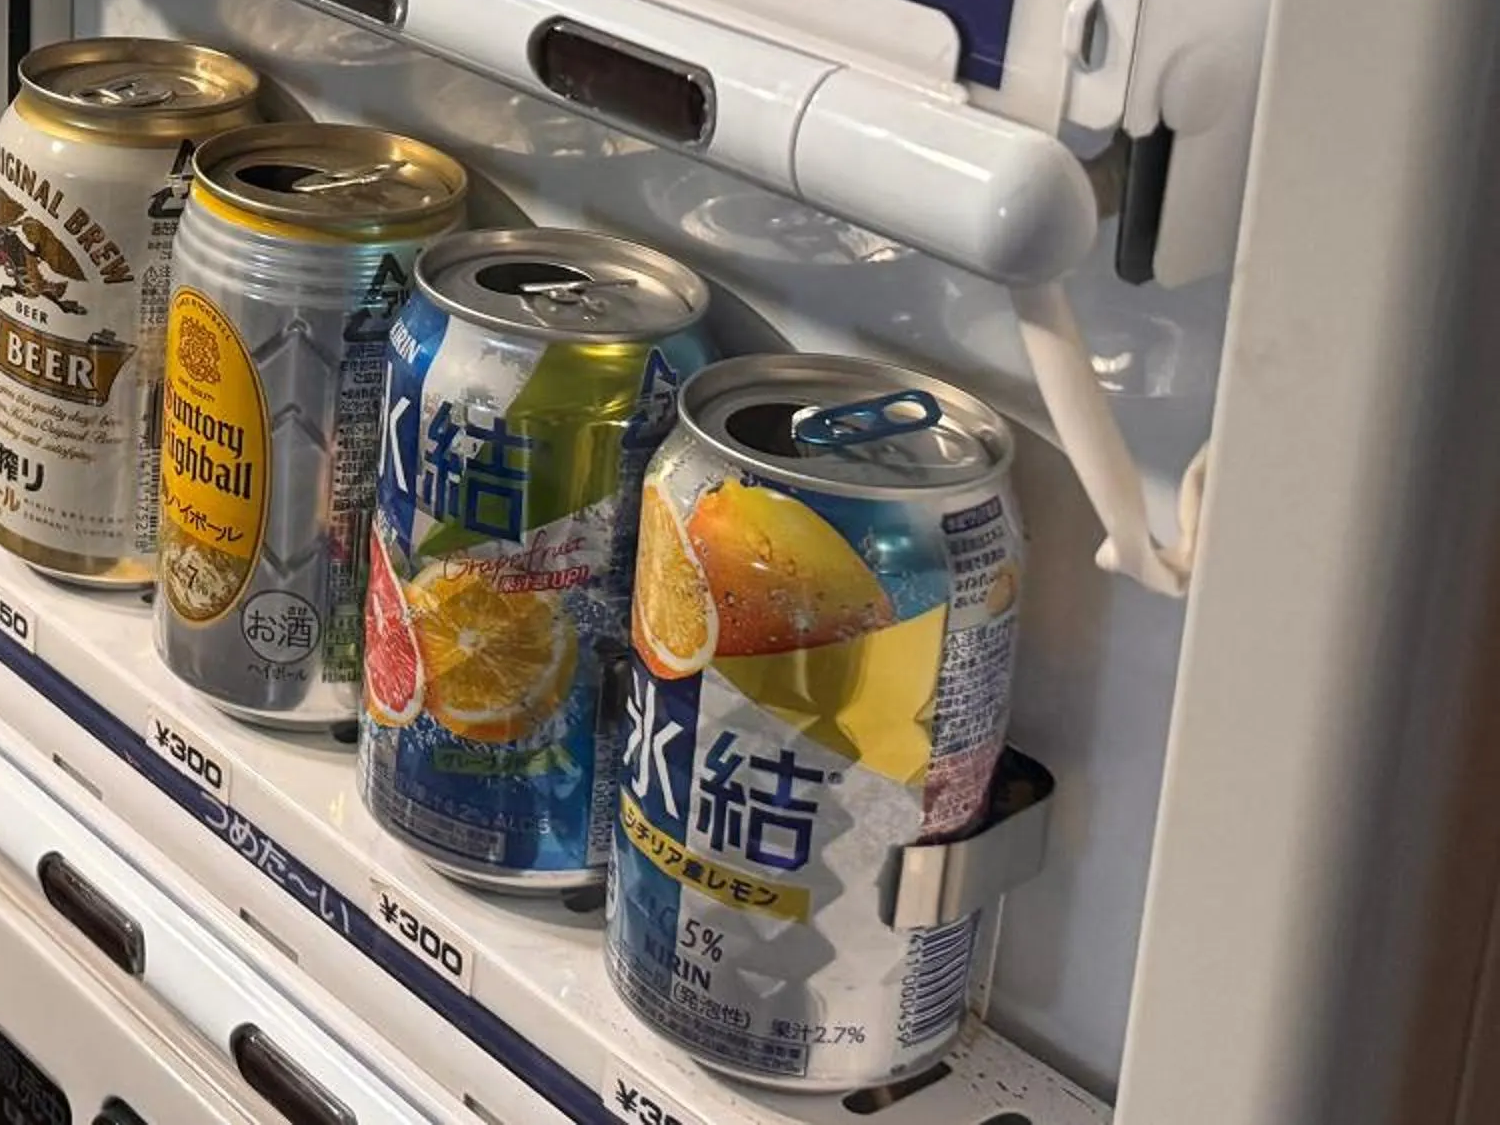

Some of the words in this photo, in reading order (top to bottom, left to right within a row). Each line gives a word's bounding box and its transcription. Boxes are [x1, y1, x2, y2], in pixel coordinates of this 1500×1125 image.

[64, 206, 135, 285] BREW
[15, 299, 49, 325] BEER
[7, 330, 95, 392] BEER
[165, 379, 245, 459] Suntory
[247, 608, 314, 649] お酒
[153, 720, 223, 790] ¥300
[622, 667, 825, 872] 氷結
[621, 807, 781, 908] シチリア産レモン
[378, 887, 464, 978] ¥300
[643, 933, 712, 992] KIRIN
[679, 918, 726, 964] 5%
[673, 981, 752, 1031] (発泡性)
[615, 1078, 683, 1125] ¥3
